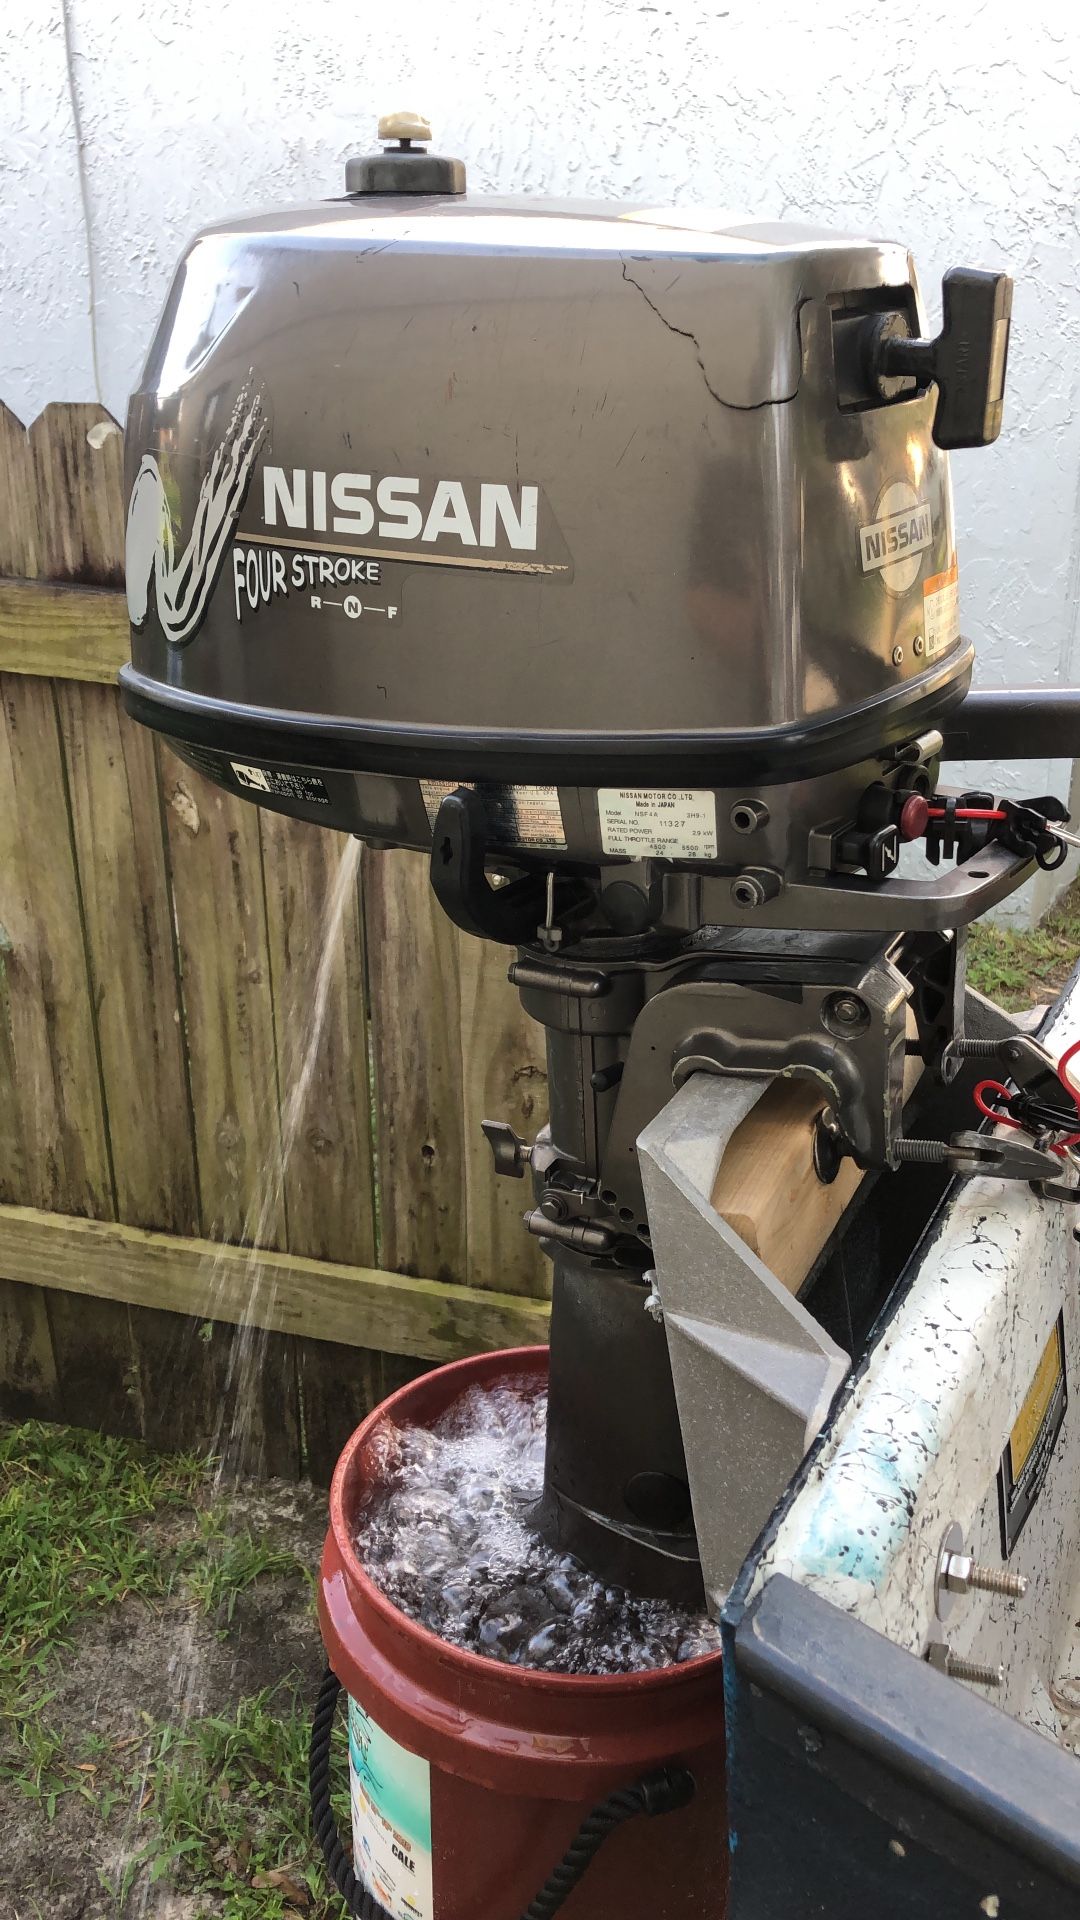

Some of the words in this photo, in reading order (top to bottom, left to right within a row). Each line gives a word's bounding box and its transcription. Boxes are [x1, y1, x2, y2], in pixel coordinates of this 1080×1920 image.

[263, 466, 538, 551] NISSAN
[865, 514, 930, 562] NISSAN
[233, 547, 289, 621] FOUR
[291, 555, 381, 588] STROKE
[310, 595, 321, 609] R
[387, 605, 398, 619] F
[659, 820, 686, 828] 11327
[391, 1843, 416, 1874] CALE
